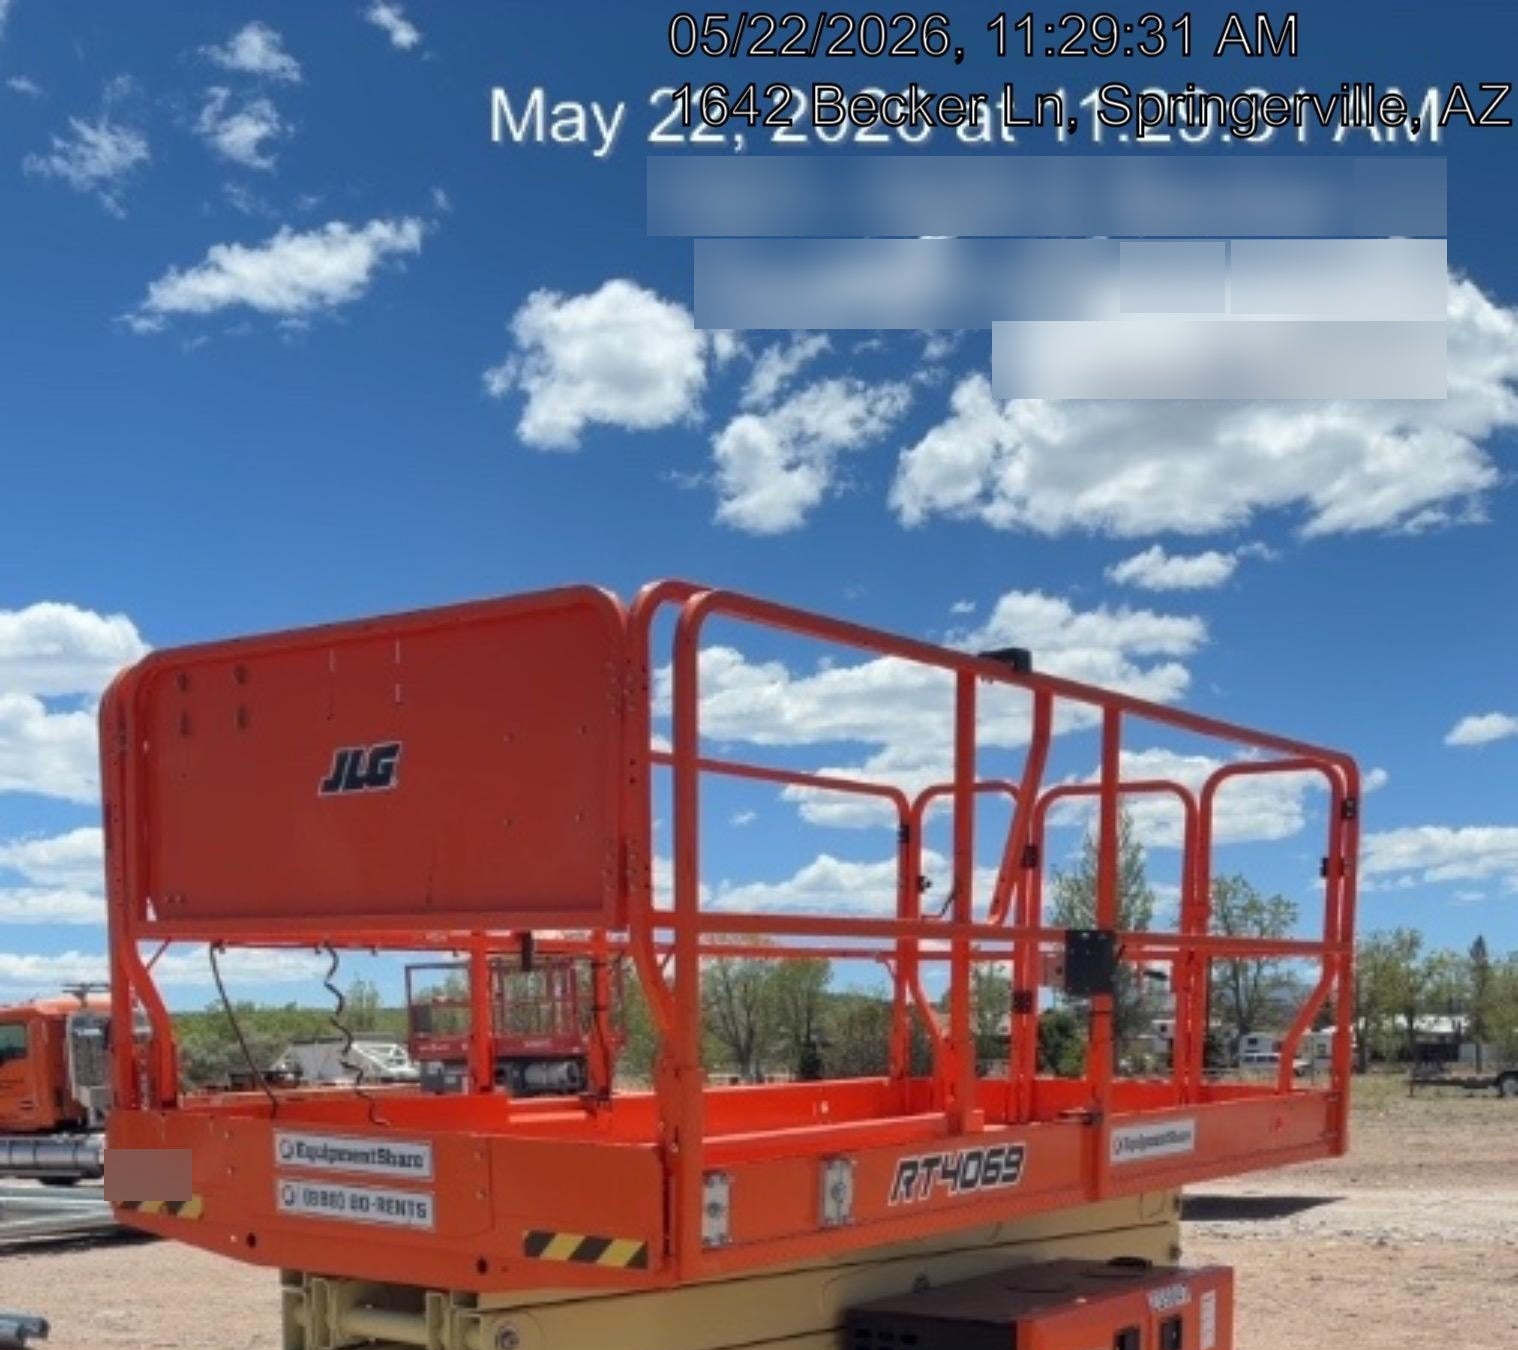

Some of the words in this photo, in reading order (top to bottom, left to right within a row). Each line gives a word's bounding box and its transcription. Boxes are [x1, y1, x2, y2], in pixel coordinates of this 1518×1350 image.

[318, 740, 402, 797] JLG
[296, 1141, 424, 1168] EquipmentShare
[887, 1142, 1027, 1206] RT4069
